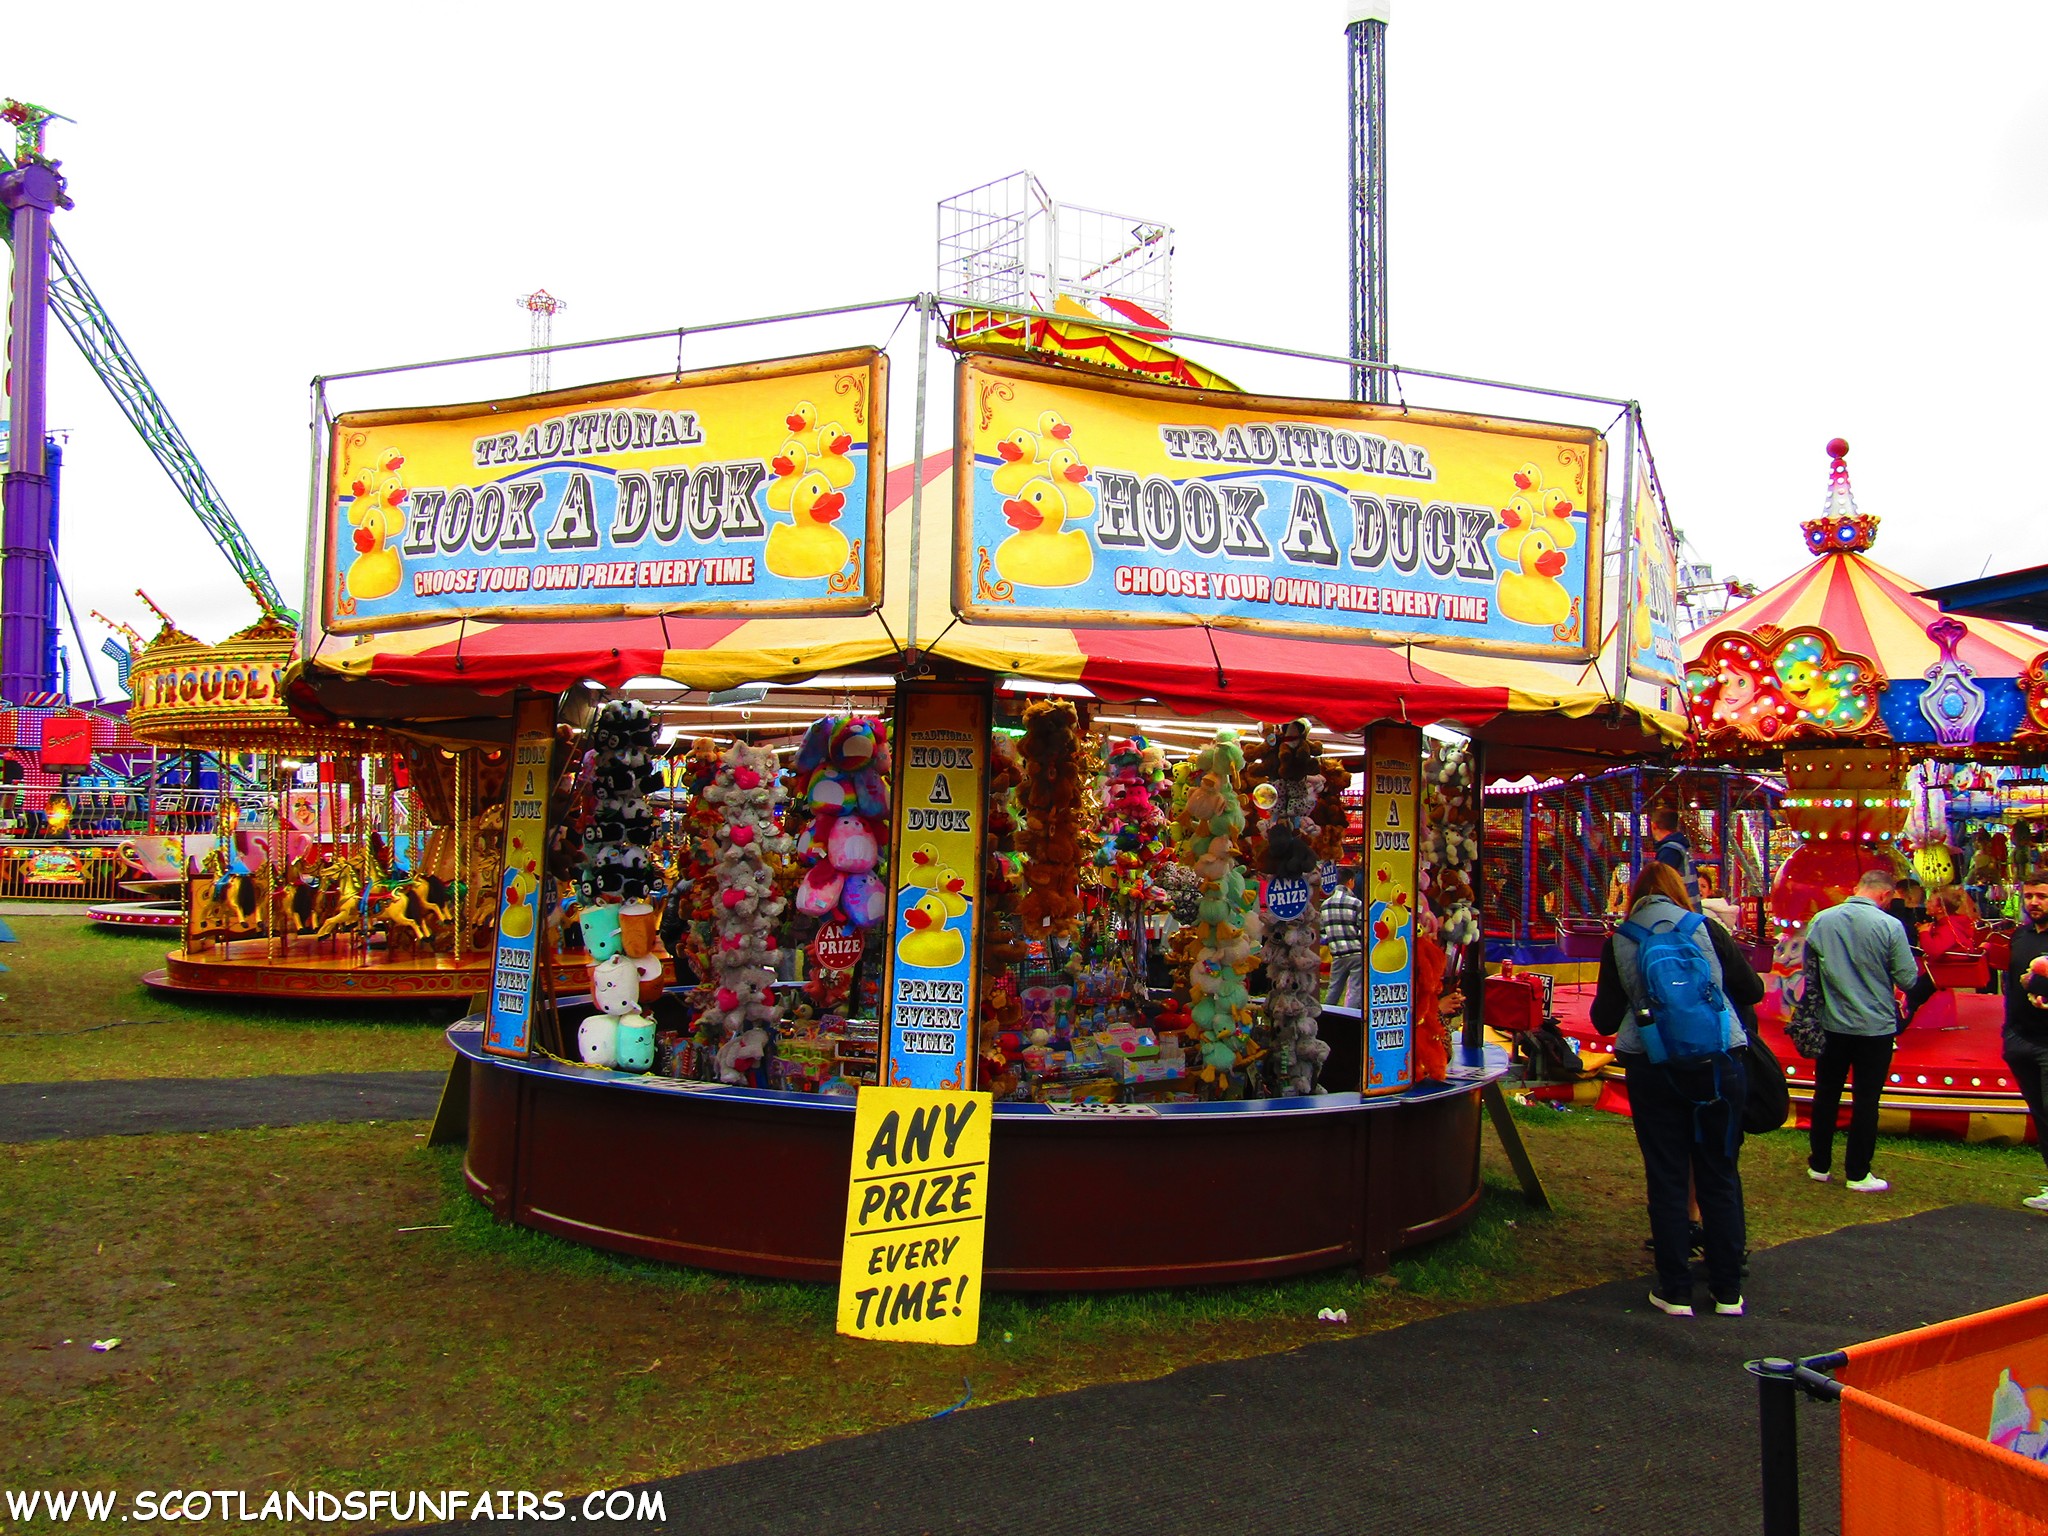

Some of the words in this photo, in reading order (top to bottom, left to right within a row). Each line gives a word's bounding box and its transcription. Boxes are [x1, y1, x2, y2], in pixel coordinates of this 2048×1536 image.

[476, 411, 702, 465] TRADITIONAL
[1163, 425, 1431, 480] TRADITIONAL
[404, 482, 544, 555] HOOK
[547, 473, 598, 549] A
[612, 463, 766, 544] DUCK
[1096, 472, 1270, 557] HOOK
[1282, 486, 1339, 566] A
[1350, 495, 1495, 580] DUCK
[414, 569, 478, 597] CHOOSE
[480, 567, 530, 593] YOUR
[532, 565, 579, 590] OWN
[581, 562, 637, 589] PRIZE
[638, 559, 701, 588] EVERY
[702, 557, 754, 585] TIME
[1115, 566, 1210, 599] CHOOSE
[1210, 573, 1270, 602] YOUR
[1274, 577, 1322, 607] OWN
[1324, 582, 1379, 613] PRIZE
[1381, 588, 1440, 618] EVERY
[1440, 595, 1488, 624] TIME
[911, 729, 973, 742] TRADITIONAL
[517, 746, 547, 765] HOOK
[911, 746, 973, 769] HOOK
[524, 769, 534, 794] A
[929, 773, 952, 803] A
[1375, 775, 1411, 795] HOOK
[512, 800, 542, 819] DUCK
[907, 809, 970, 832] DUCK
[1386, 798, 1399, 826] A
[1374, 831, 1410, 851] DUCK
[1321, 873, 1337, 886] PRIZE
[1269, 889, 1307, 907] PRIZE
[825, 925, 853, 939] AN
[498, 948, 531, 970] PRIZE
[819, 940, 860, 955] PRIZE
[496, 970, 529, 992] EVERY
[899, 979, 964, 1003] PRIZE
[499, 992, 524, 1014] TIME
[1372, 983, 1408, 1005] PRIZE
[896, 1004, 964, 1029] EVERY
[1371, 1006, 1409, 1028] EVERY
[903, 1031, 954, 1055] TIME
[1376, 1029, 1404, 1050] TIME
[866, 1100, 977, 1170] ANY
[858, 1172, 976, 1226] PRIZE
[867, 1235, 960, 1275] EVERY
[855, 1274, 969, 1330] TIME!
